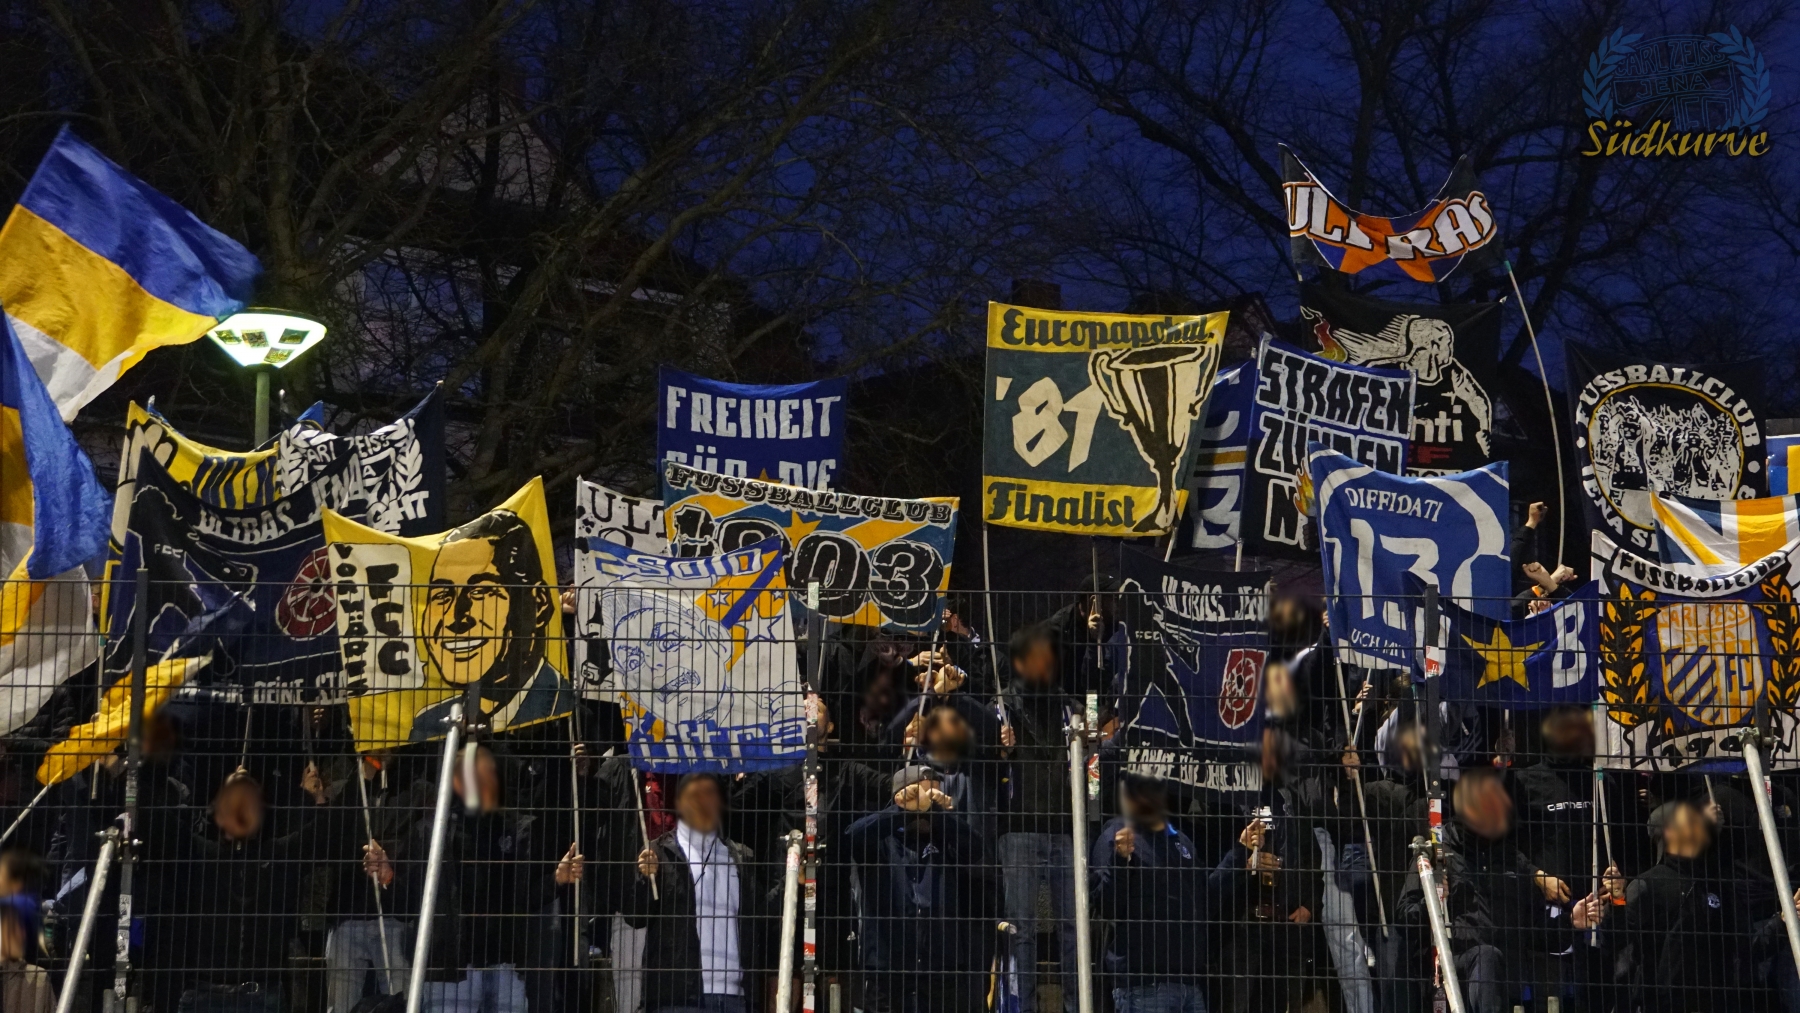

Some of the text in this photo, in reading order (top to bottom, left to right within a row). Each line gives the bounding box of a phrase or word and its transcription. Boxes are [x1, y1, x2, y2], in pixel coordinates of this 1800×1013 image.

[667, 385, 841, 440] FREIHEIT
[1257, 346, 1412, 437] STRAFEN
[1576, 364, 1760, 447] FUSSBALLCLUB
[1256, 411, 1402, 478] ZÜEN
[665, 464, 953, 528] FUSSBALLCLUB
[987, 481, 1137, 527] Finalist
[1345, 487, 1443, 522] DIFFIDATI
[197, 502, 297, 545] ULTRAS
[1619, 551, 1785, 592] FUSSBALLCLUB
[1162, 575, 1225, 622] ULTRAS
[1726, 655, 1754, 692] FC
[1662, 735, 1745, 768] 190
